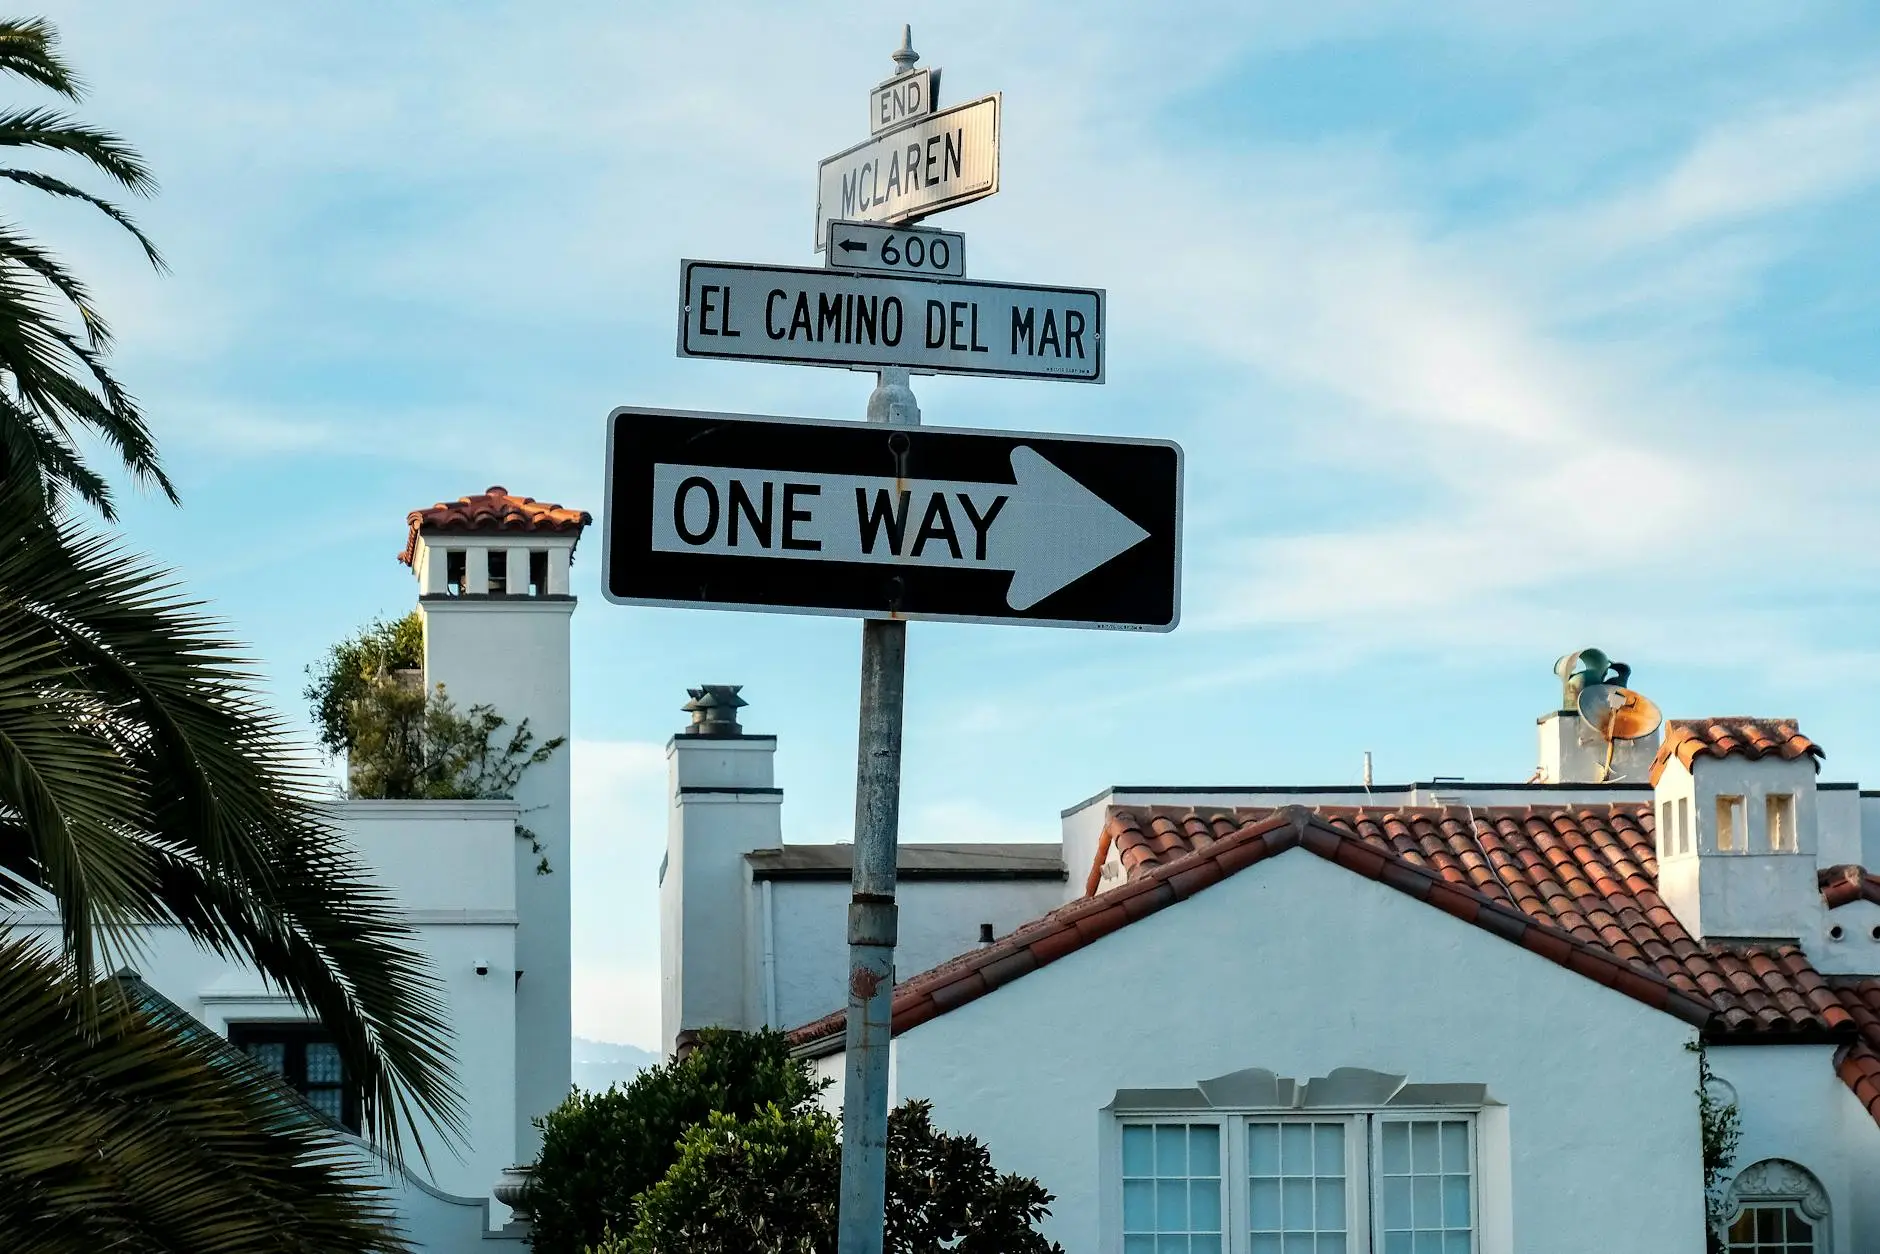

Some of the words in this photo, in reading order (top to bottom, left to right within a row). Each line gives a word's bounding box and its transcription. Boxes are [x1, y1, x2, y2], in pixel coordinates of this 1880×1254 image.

[880, 82, 921, 124] END
[842, 129, 962, 220] MCLAREN
[881, 235, 950, 270] 600
[700, 285, 741, 337] EL
[765, 289, 903, 347] CAMINO
[926, 300, 989, 352] DEL
[1011, 306, 1086, 359] MAR
[673, 476, 822, 552] ONE
[855, 487, 1009, 561] WAY
